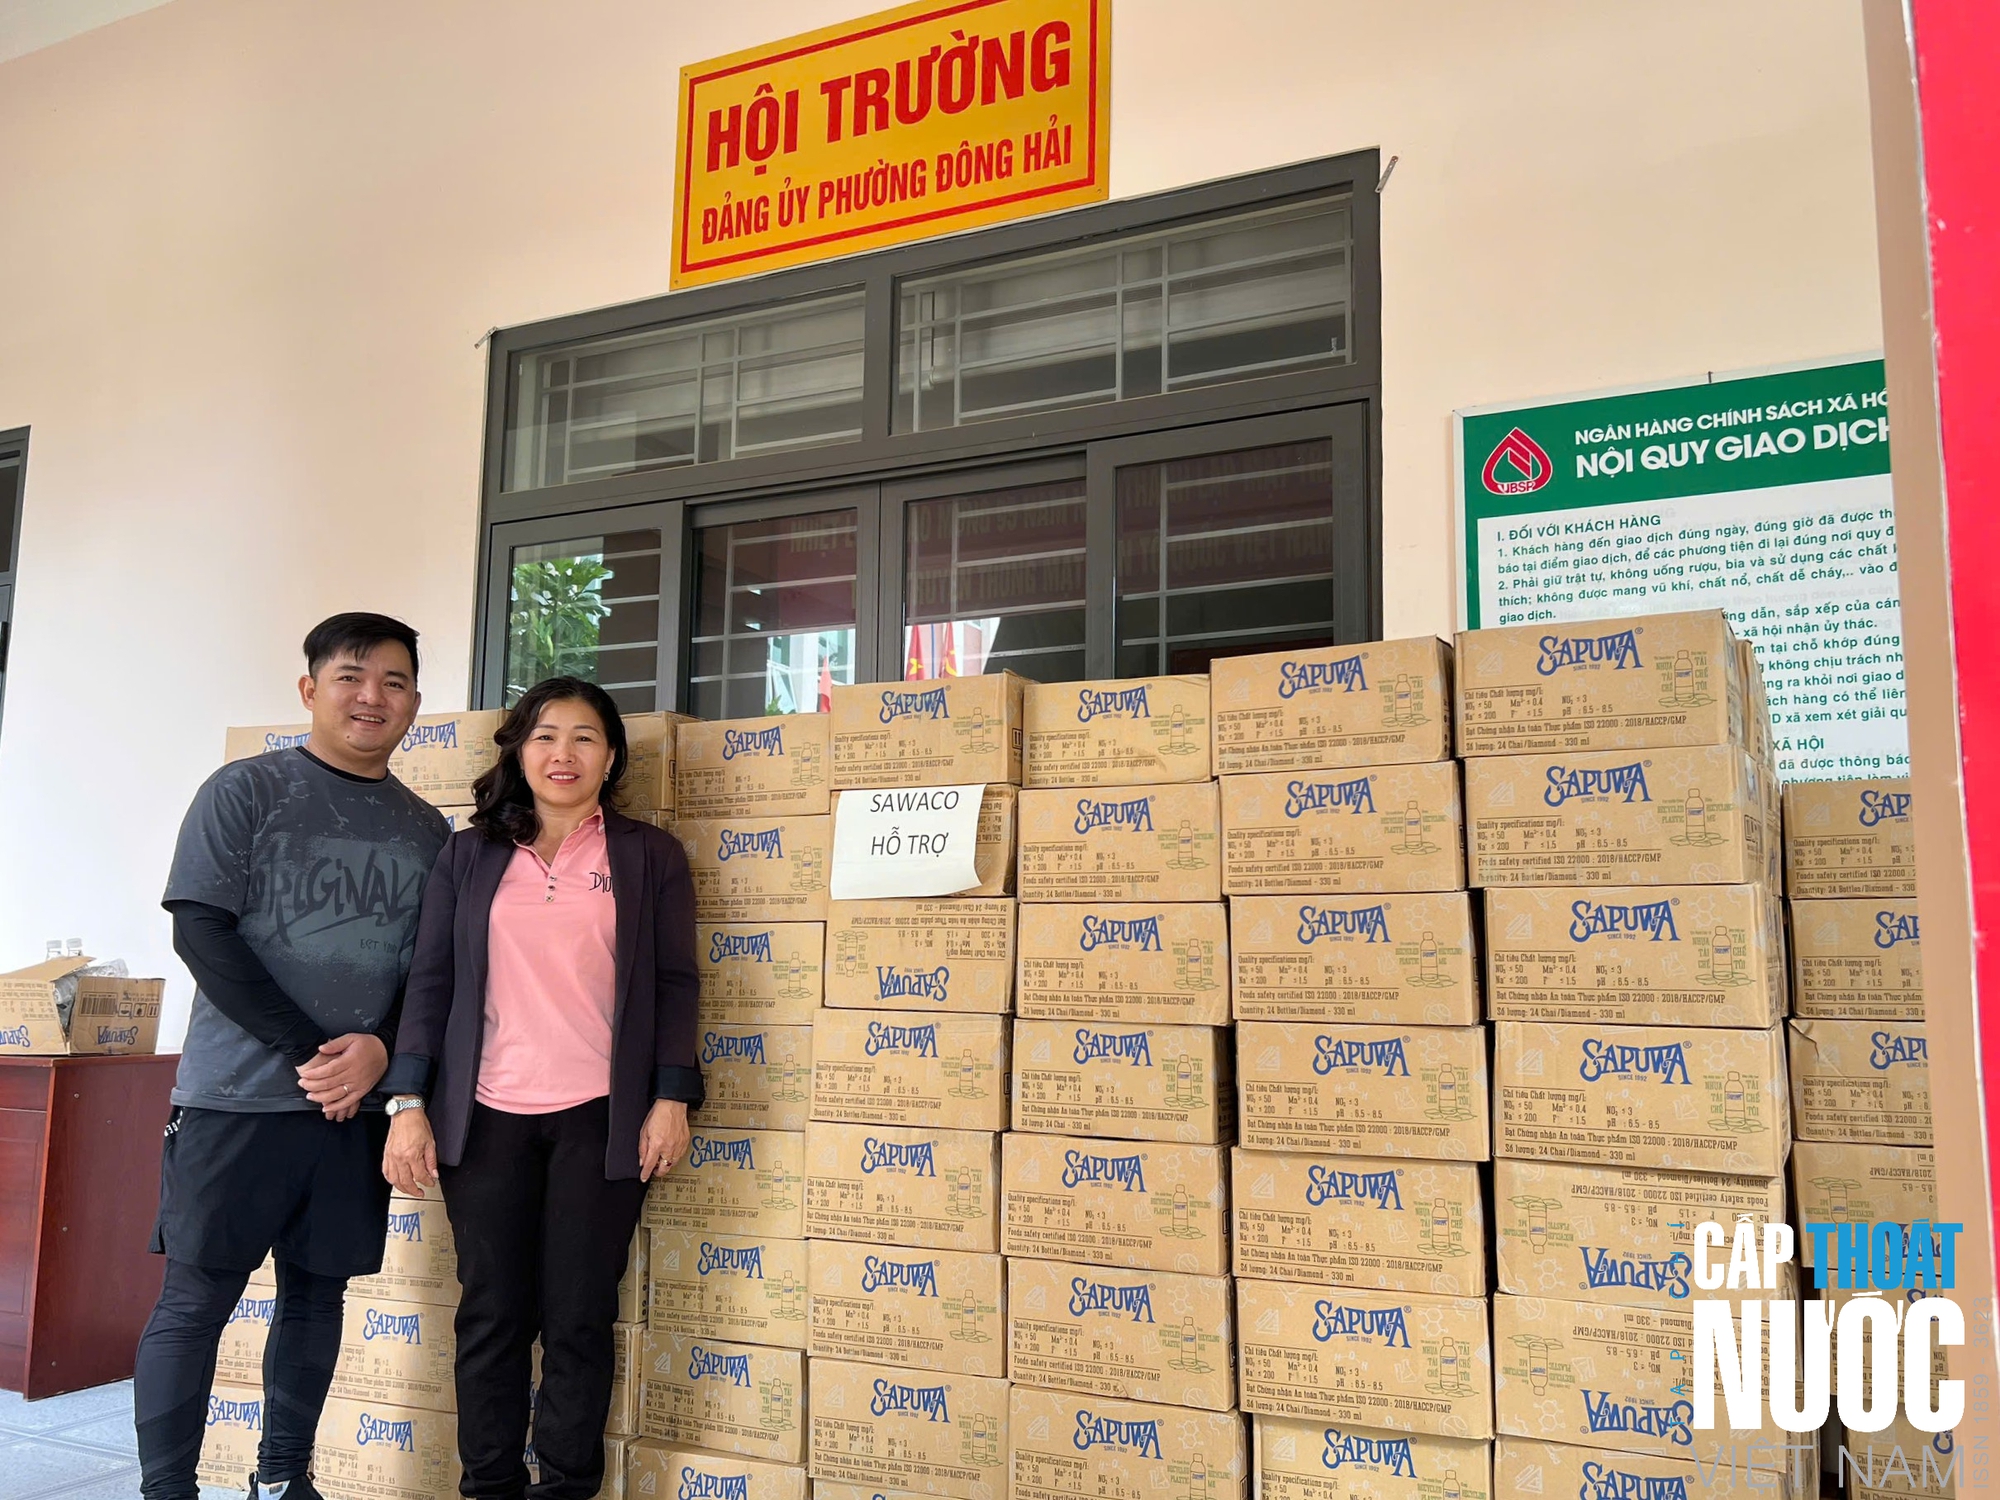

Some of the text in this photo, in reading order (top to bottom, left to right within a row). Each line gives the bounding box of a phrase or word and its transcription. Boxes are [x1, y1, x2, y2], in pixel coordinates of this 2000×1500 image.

[706, 20, 1070, 174] HỘI TRƯỜNG
[702, 114, 1071, 244] ĐẢNG ỦY PHƯỜNG ĐÔNG HẢI
[1575, 391, 1857, 445] NGÂN HÀNG CHÍNH SÁCH XÃ
[1576, 446, 1634, 479] NỘI
[1641, 439, 1710, 470] QUY
[1716, 428, 1805, 461] GIAO
[1498, 515, 1661, 541] I. ĐỐI VỚI KHÁCH HÀNG
[1498, 512, 1874, 557] 1. Khách hàng đến giao dịch đúng ngày, đúng giờ đã được
[1498, 544, 1887, 590] 2. Phải giữ trật tự, không uống rượu, bia và sử dụng các chất
[1499, 530, 1881, 574] báo tại điểm giao dịch, để các phương tiện đi lại đúng nơi quy
[1500, 610, 1557, 625] giao dịch.
[1744, 620, 1877, 637] xã hội nhận ủy thác.
[1752, 600, 1900, 619] dẫn, sắp xếp của cán
[1536, 629, 1644, 676] SAPUWA
[1278, 655, 1369, 699] SAPUWA
[879, 686, 950, 724] SAPUWA
[1786, 707, 1886, 723] xã xem xét giải
[401, 721, 458, 752] SAPUWA
[722, 725, 784, 761] SAPUWA
[1773, 736, 1824, 751] XÃ HỘI
[1780, 756, 1881, 770] đã được thông
[870, 791, 959, 813] SAWACO
[1285, 777, 1377, 819] SAPUWA
[1543, 762, 1653, 808] SAPUWA
[1074, 797, 1154, 834] SAPUWA
[718, 827, 784, 862] SAPUWA
[871, 826, 949, 858] HỖ TRỢ
[1297, 904, 1392, 945] SAPUWA
[1569, 899, 1681, 943] SAPUWA
[97, 1025, 138, 1045] SAPUWA
[865, 1021, 939, 1058] SAPUWA
[1073, 1028, 1153, 1067] SAPUWA
[1312, 1034, 1411, 1077] SAPUWA
[1580, 1038, 1693, 1085] SAPUWA
[861, 1137, 936, 1178] SAPUWA
[1539, 1146, 1636, 1161] 24 330 ml
[1629, 1135, 1641, 1145] ISO
[1643, 1136, 1666, 1147] 22000
[1672, 1137, 1738, 1150] 2018/HACCP/GMP
[1062, 1149, 1147, 1192] SAPUWA
[1306, 1164, 1404, 1210] SAPUWA
[1634, 1172, 1648, 1181] 330
[1571, 1185, 1668, 1201] 22000 2018/HACCP/GMP
[697, 1242, 764, 1279] SAPUWA
[861, 1255, 939, 1298] SAPUWA
[1578, 1246, 1692, 1299] SAPUWA
[1069, 1276, 1156, 1324] SAPUWA
[363, 1309, 422, 1345] SAPUWA
[1312, 1299, 1412, 1349] SAPUWA
[870, 1378, 950, 1424] SAPUWA
[1580, 1389, 1694, 1445] SAPUWA
[356, 1413, 414, 1452] SAPUWA
[1073, 1409, 1164, 1460] SAPUWA
[1322, 1428, 1418, 1478] SAPUWA
